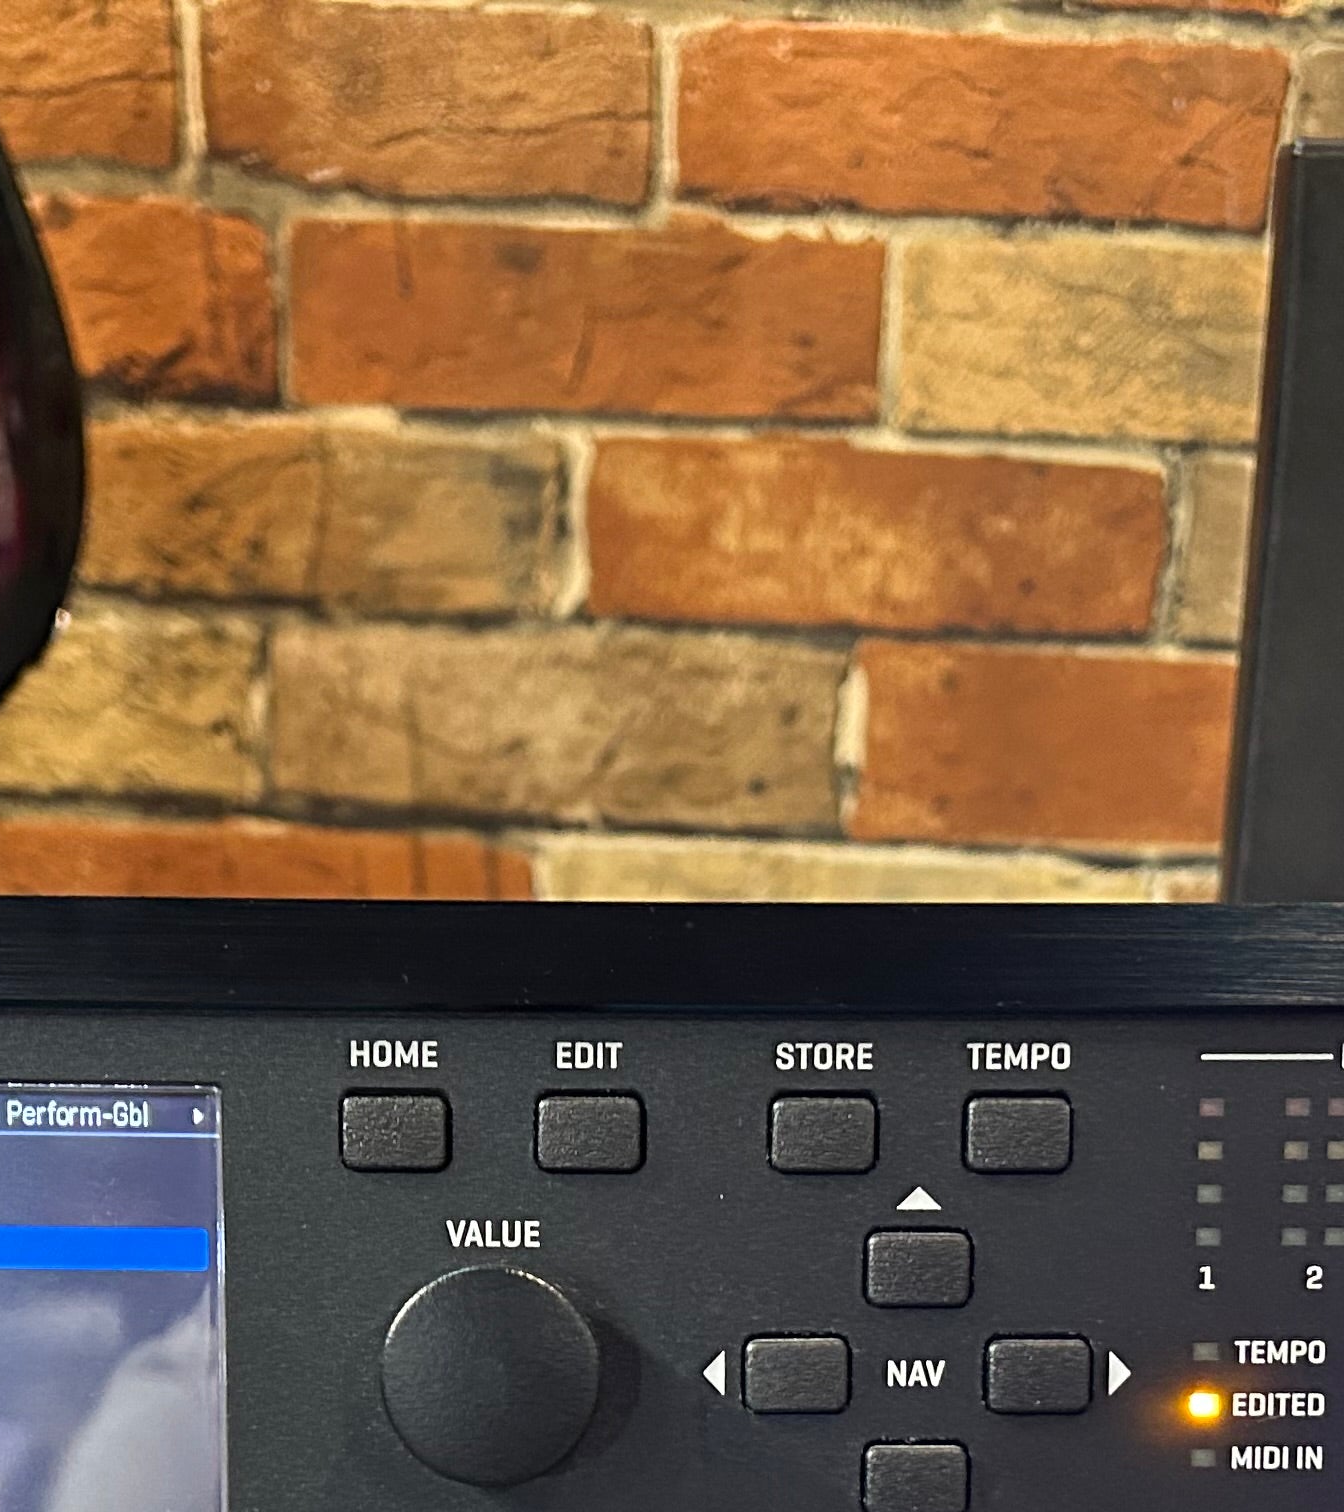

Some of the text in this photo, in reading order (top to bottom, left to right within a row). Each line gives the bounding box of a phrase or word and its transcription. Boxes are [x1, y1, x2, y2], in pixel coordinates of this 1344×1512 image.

[350, 1039, 439, 1068] HOME
[556, 1041, 623, 1070] EDIT
[775, 1042, 874, 1071] STORE
[966, 1042, 1071, 1071] TEMPO
[6, 1100, 150, 1128] Perform-Gbl
[445, 1219, 541, 1248] VALUE
[1198, 1265, 1216, 1290] 1
[1306, 1265, 1323, 1290] 2
[1234, 1339, 1326, 1365] TEMPO
[887, 1359, 946, 1388] NAV
[1231, 1392, 1325, 1417] EDITED
[1231, 1444, 1324, 1470] MIDI IN
